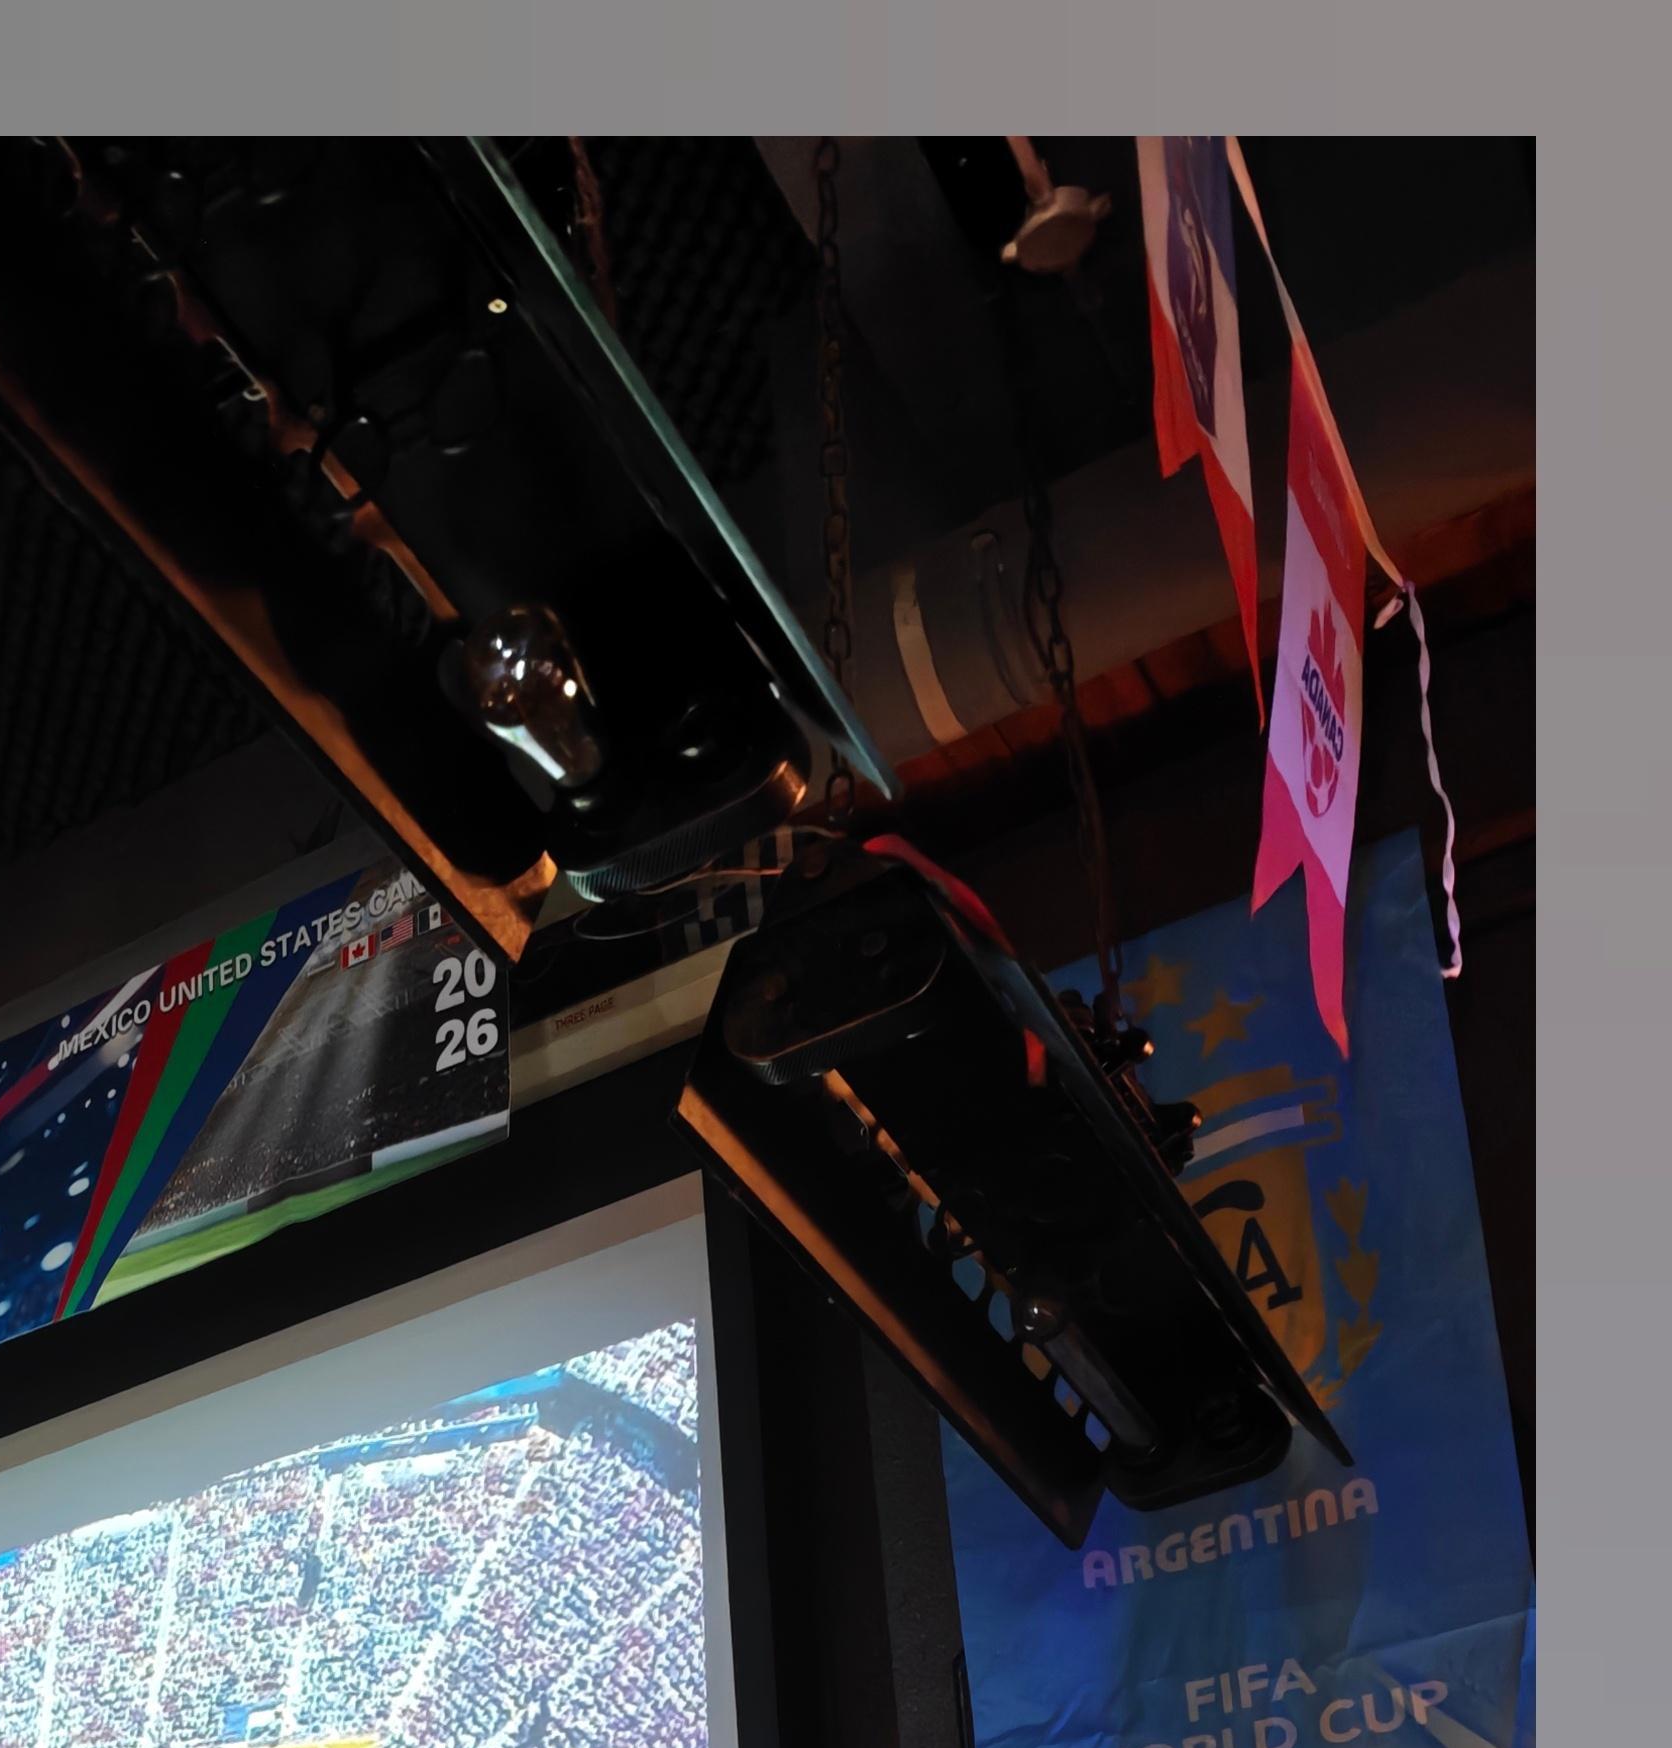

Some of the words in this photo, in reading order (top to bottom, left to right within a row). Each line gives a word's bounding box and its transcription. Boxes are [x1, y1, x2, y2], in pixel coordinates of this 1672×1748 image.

[56, 998, 152, 1062] MEXICO
[158, 951, 253, 1014] UNITED
[259, 900, 363, 967] STATES
[432, 948, 497, 1012] 20
[434, 1007, 499, 1072] 26
[1082, 1476, 1380, 1590] ARGENTINA
[1184, 1655, 1318, 1725] FIFA
[1316, 1678, 1450, 1744] CUP
